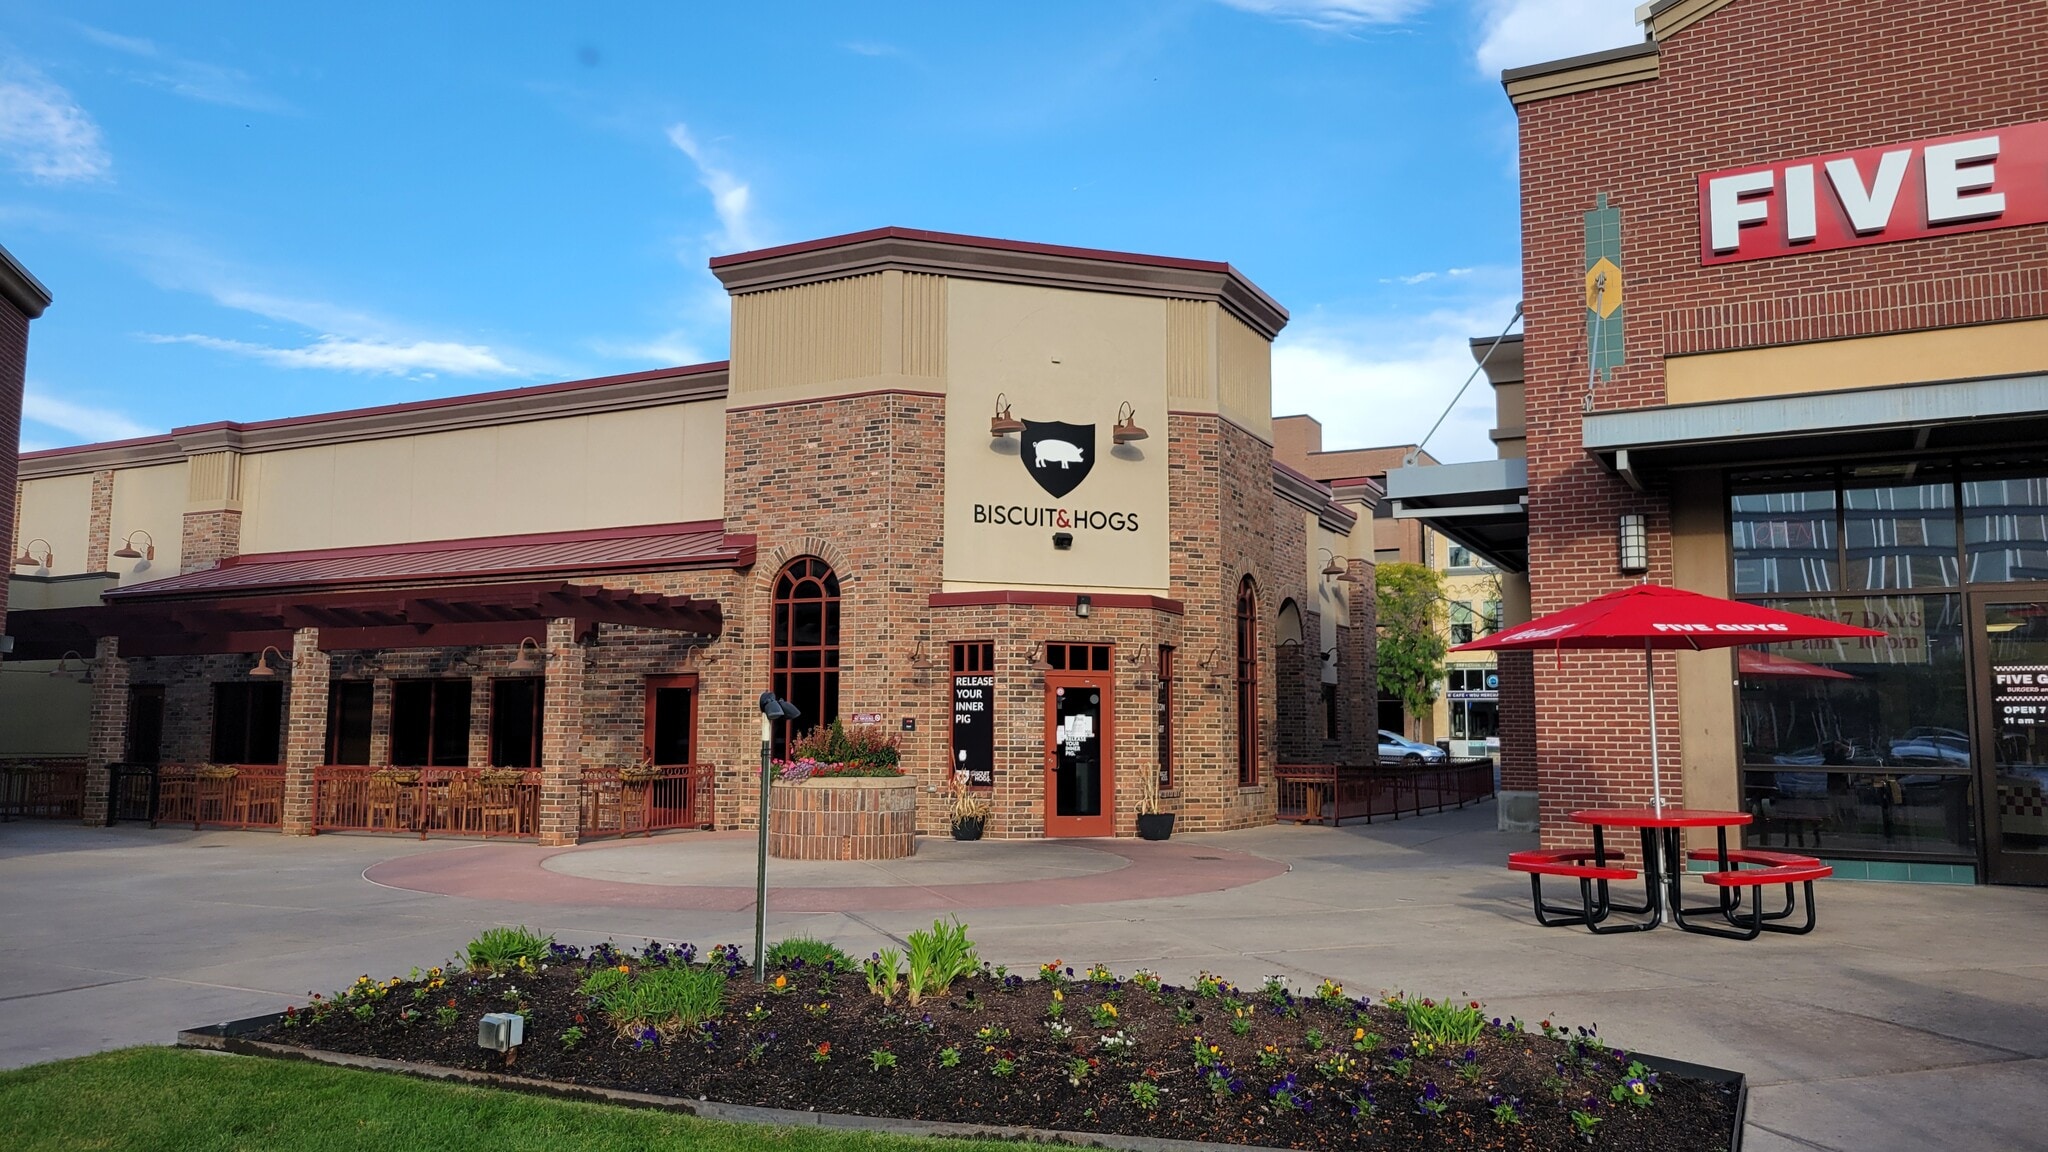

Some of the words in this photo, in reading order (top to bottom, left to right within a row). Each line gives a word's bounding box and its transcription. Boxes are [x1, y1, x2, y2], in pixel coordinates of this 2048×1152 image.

[1709, 135, 2006, 252] FIVE
[1862, 612, 1922, 628] DAYS
[1652, 623, 1714, 631] FIVE
[1716, 623, 1788, 631] GUYS
[956, 676, 994, 686] RELEASE
[1997, 675, 2033, 684] FIVE
[956, 689, 983, 699] YOUR
[955, 702, 984, 711] INNER
[2004, 706, 2036, 714] OPEN
[2039, 706, 2046, 714] 7
[955, 714, 971, 724] PIG
